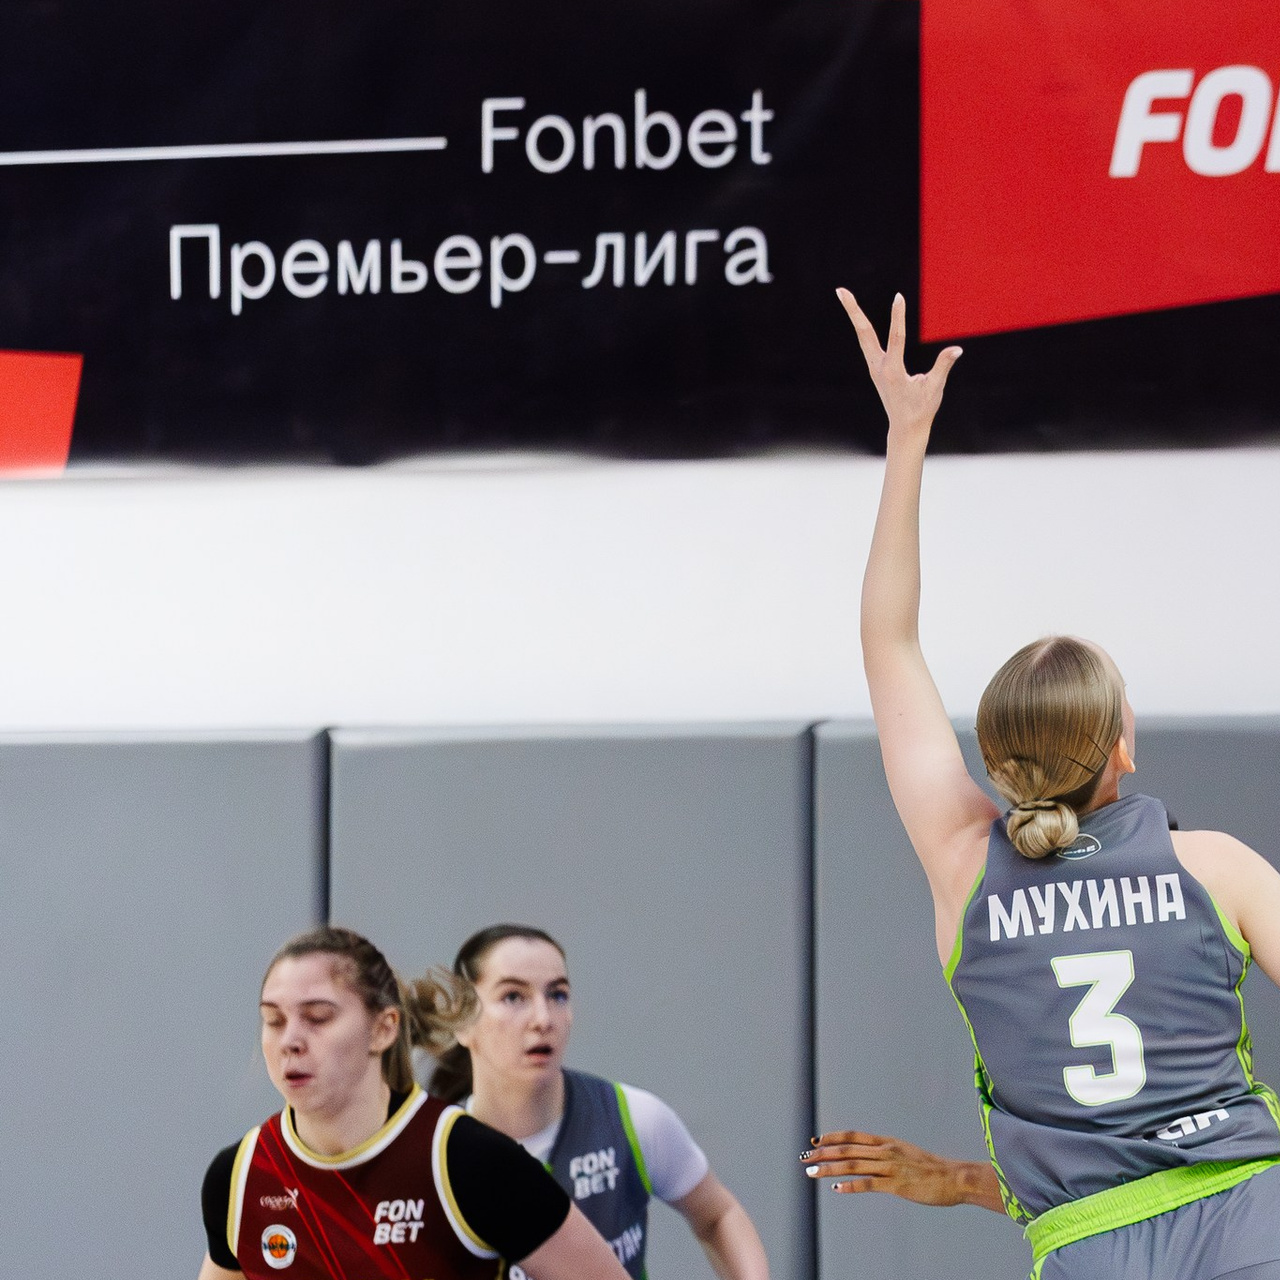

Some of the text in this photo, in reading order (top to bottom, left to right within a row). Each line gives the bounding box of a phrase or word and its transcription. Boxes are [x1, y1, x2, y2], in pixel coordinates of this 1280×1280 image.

[480, 89, 775, 174] Fonbet
[168, 223, 774, 316] Премьер-лига
[987, 872, 1187, 942] МУХИНА
[1050, 949, 1147, 1107] 3
[373, 1221, 425, 1246] BET
[374, 1198, 425, 1224] FON
